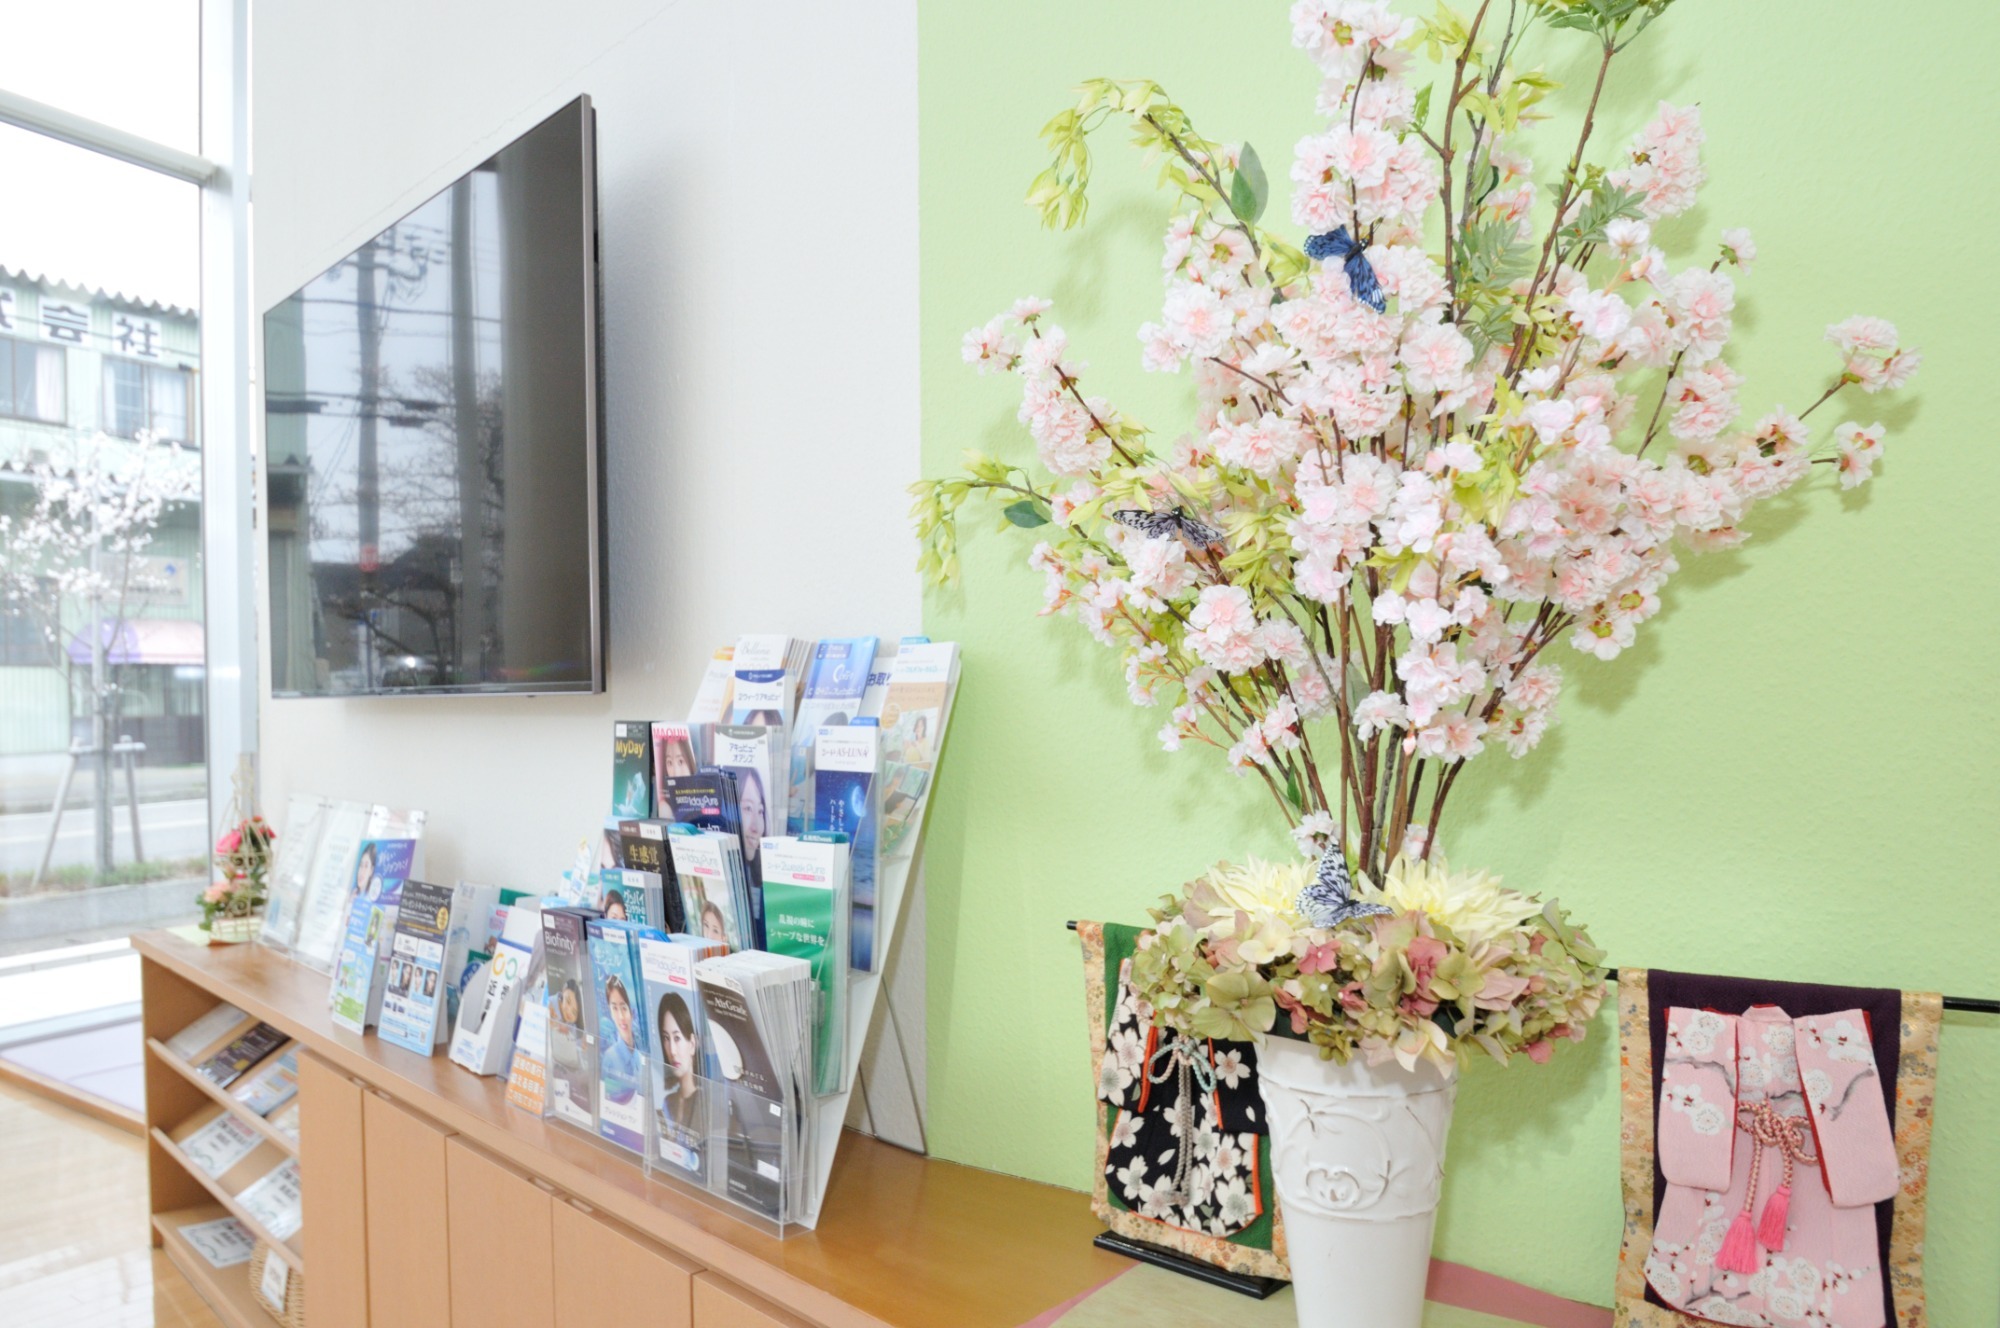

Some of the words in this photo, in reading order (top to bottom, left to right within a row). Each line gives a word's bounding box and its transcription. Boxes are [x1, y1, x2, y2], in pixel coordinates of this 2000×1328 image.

[615, 739, 645, 758] MyDay
[629, 844, 660, 865] 生感覚
[544, 930, 576, 955] Biofinity
